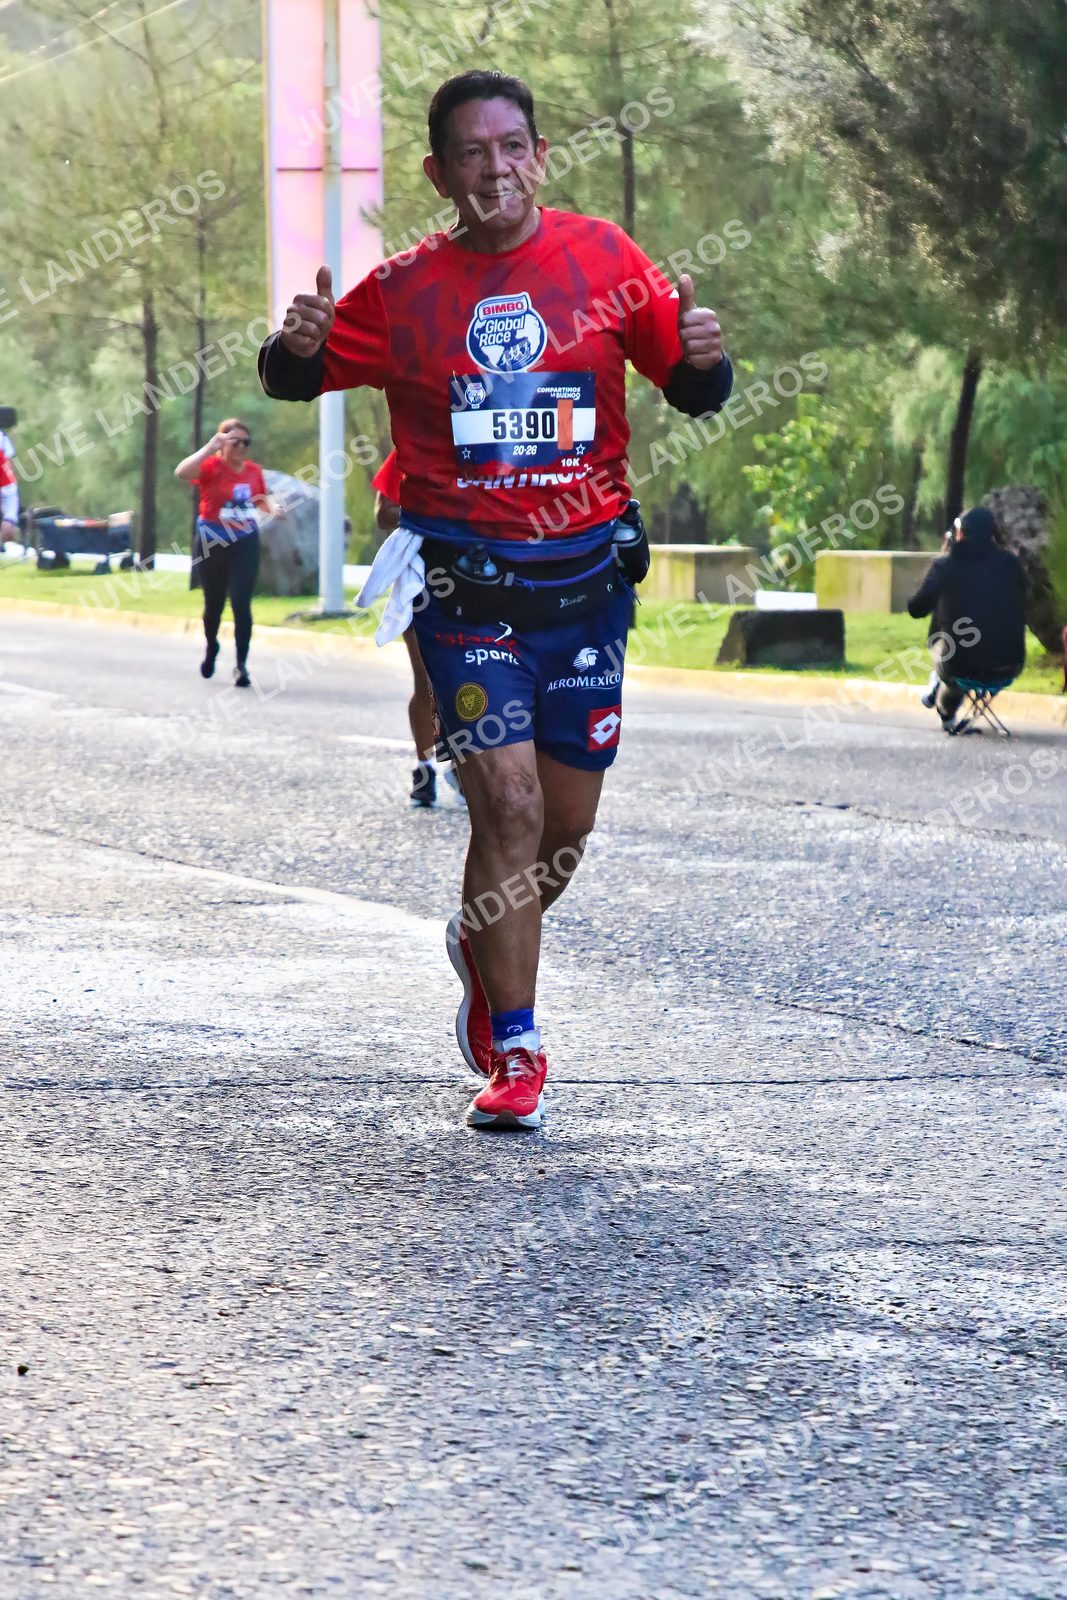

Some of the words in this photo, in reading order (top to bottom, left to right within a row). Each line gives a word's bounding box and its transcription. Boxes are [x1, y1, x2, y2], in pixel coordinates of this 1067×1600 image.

[483, 301, 524, 315] BIMBO
[485, 314, 525, 333] Global
[479, 331, 511, 347] Race
[492, 411, 555, 440] 5390
[561, 458, 580, 467] 10K
[546, 672, 621, 692] AEROMEXICO
